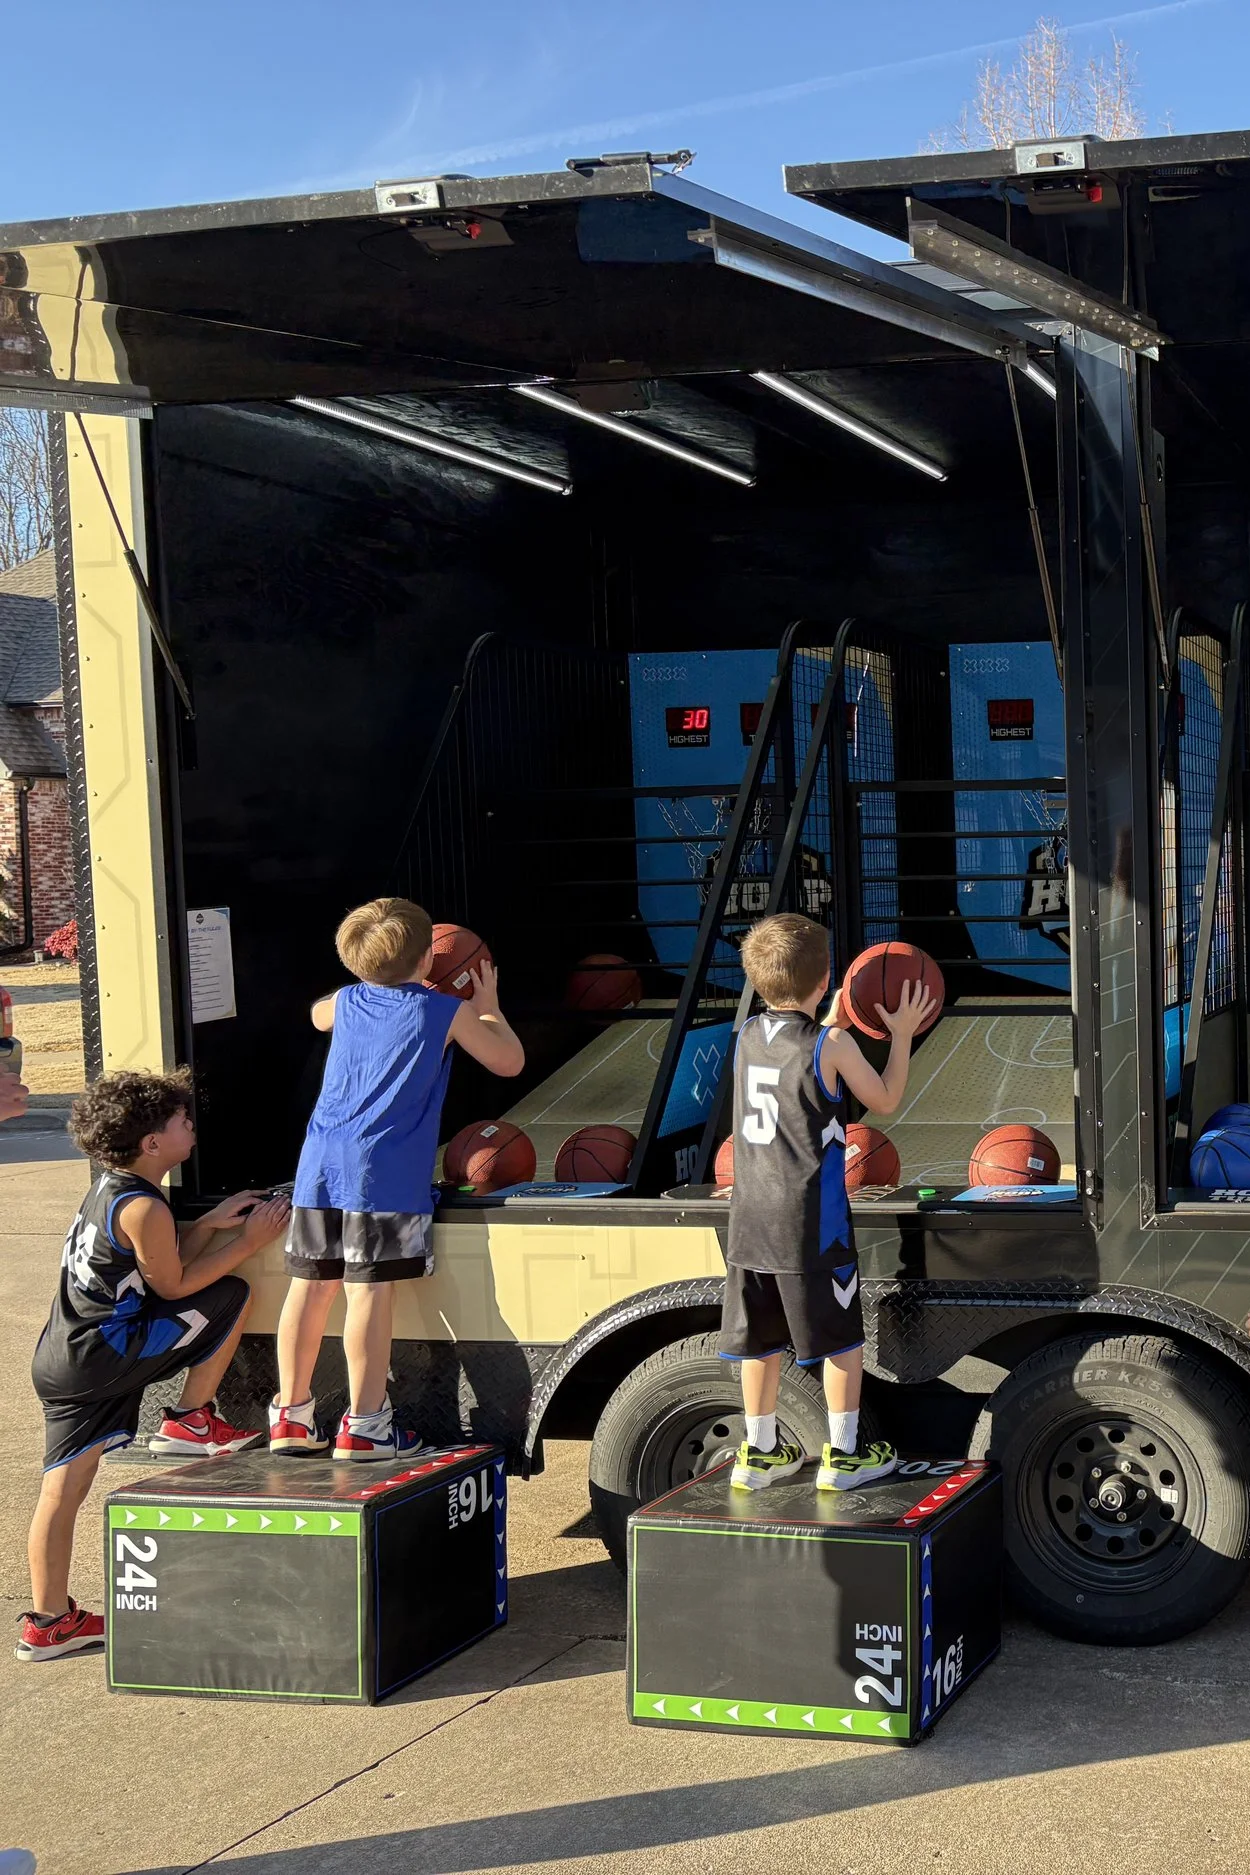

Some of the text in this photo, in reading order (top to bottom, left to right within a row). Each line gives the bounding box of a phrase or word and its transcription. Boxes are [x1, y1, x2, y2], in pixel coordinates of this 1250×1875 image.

[669, 735, 708, 743] HIGHEST
[683, 709, 708, 729] 30
[991, 728, 1032, 737] HIGHEST
[724, 879, 832, 915] OP
[742, 1065, 781, 1145] 5
[898, 1460, 965, 1475] 20
[448, 1483, 459, 1530] INCH
[459, 1468, 493, 1523] 16
[116, 1534, 158, 1592] 24
[116, 1593, 157, 1611] INCH
[855, 1623, 903, 1642] INCH
[854, 1644, 902, 1707] 24
[932, 1644, 956, 1708] 16
[955, 1634, 964, 1685] INCH
